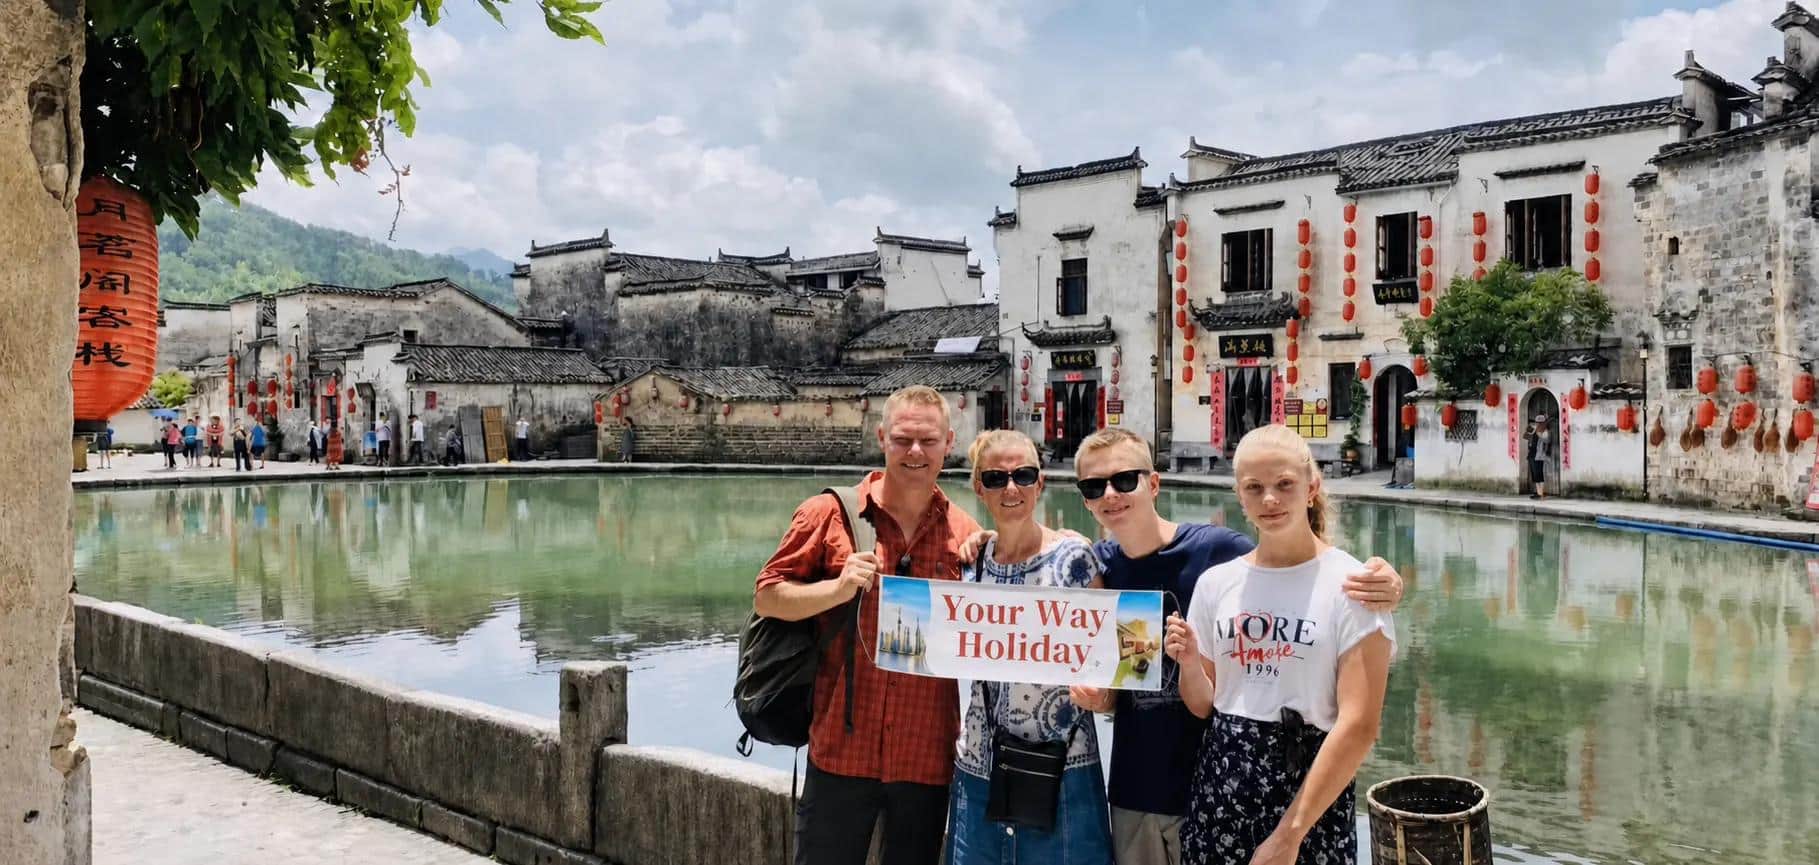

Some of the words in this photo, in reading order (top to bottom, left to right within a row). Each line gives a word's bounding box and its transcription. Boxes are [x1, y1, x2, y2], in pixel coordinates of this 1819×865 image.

[942, 594, 1024, 626] Your
[1035, 599, 1108, 637] Way
[1217, 615, 1316, 645] MORE
[956, 631, 1092, 672] Holiday
[1246, 664, 1280, 677] 1996
